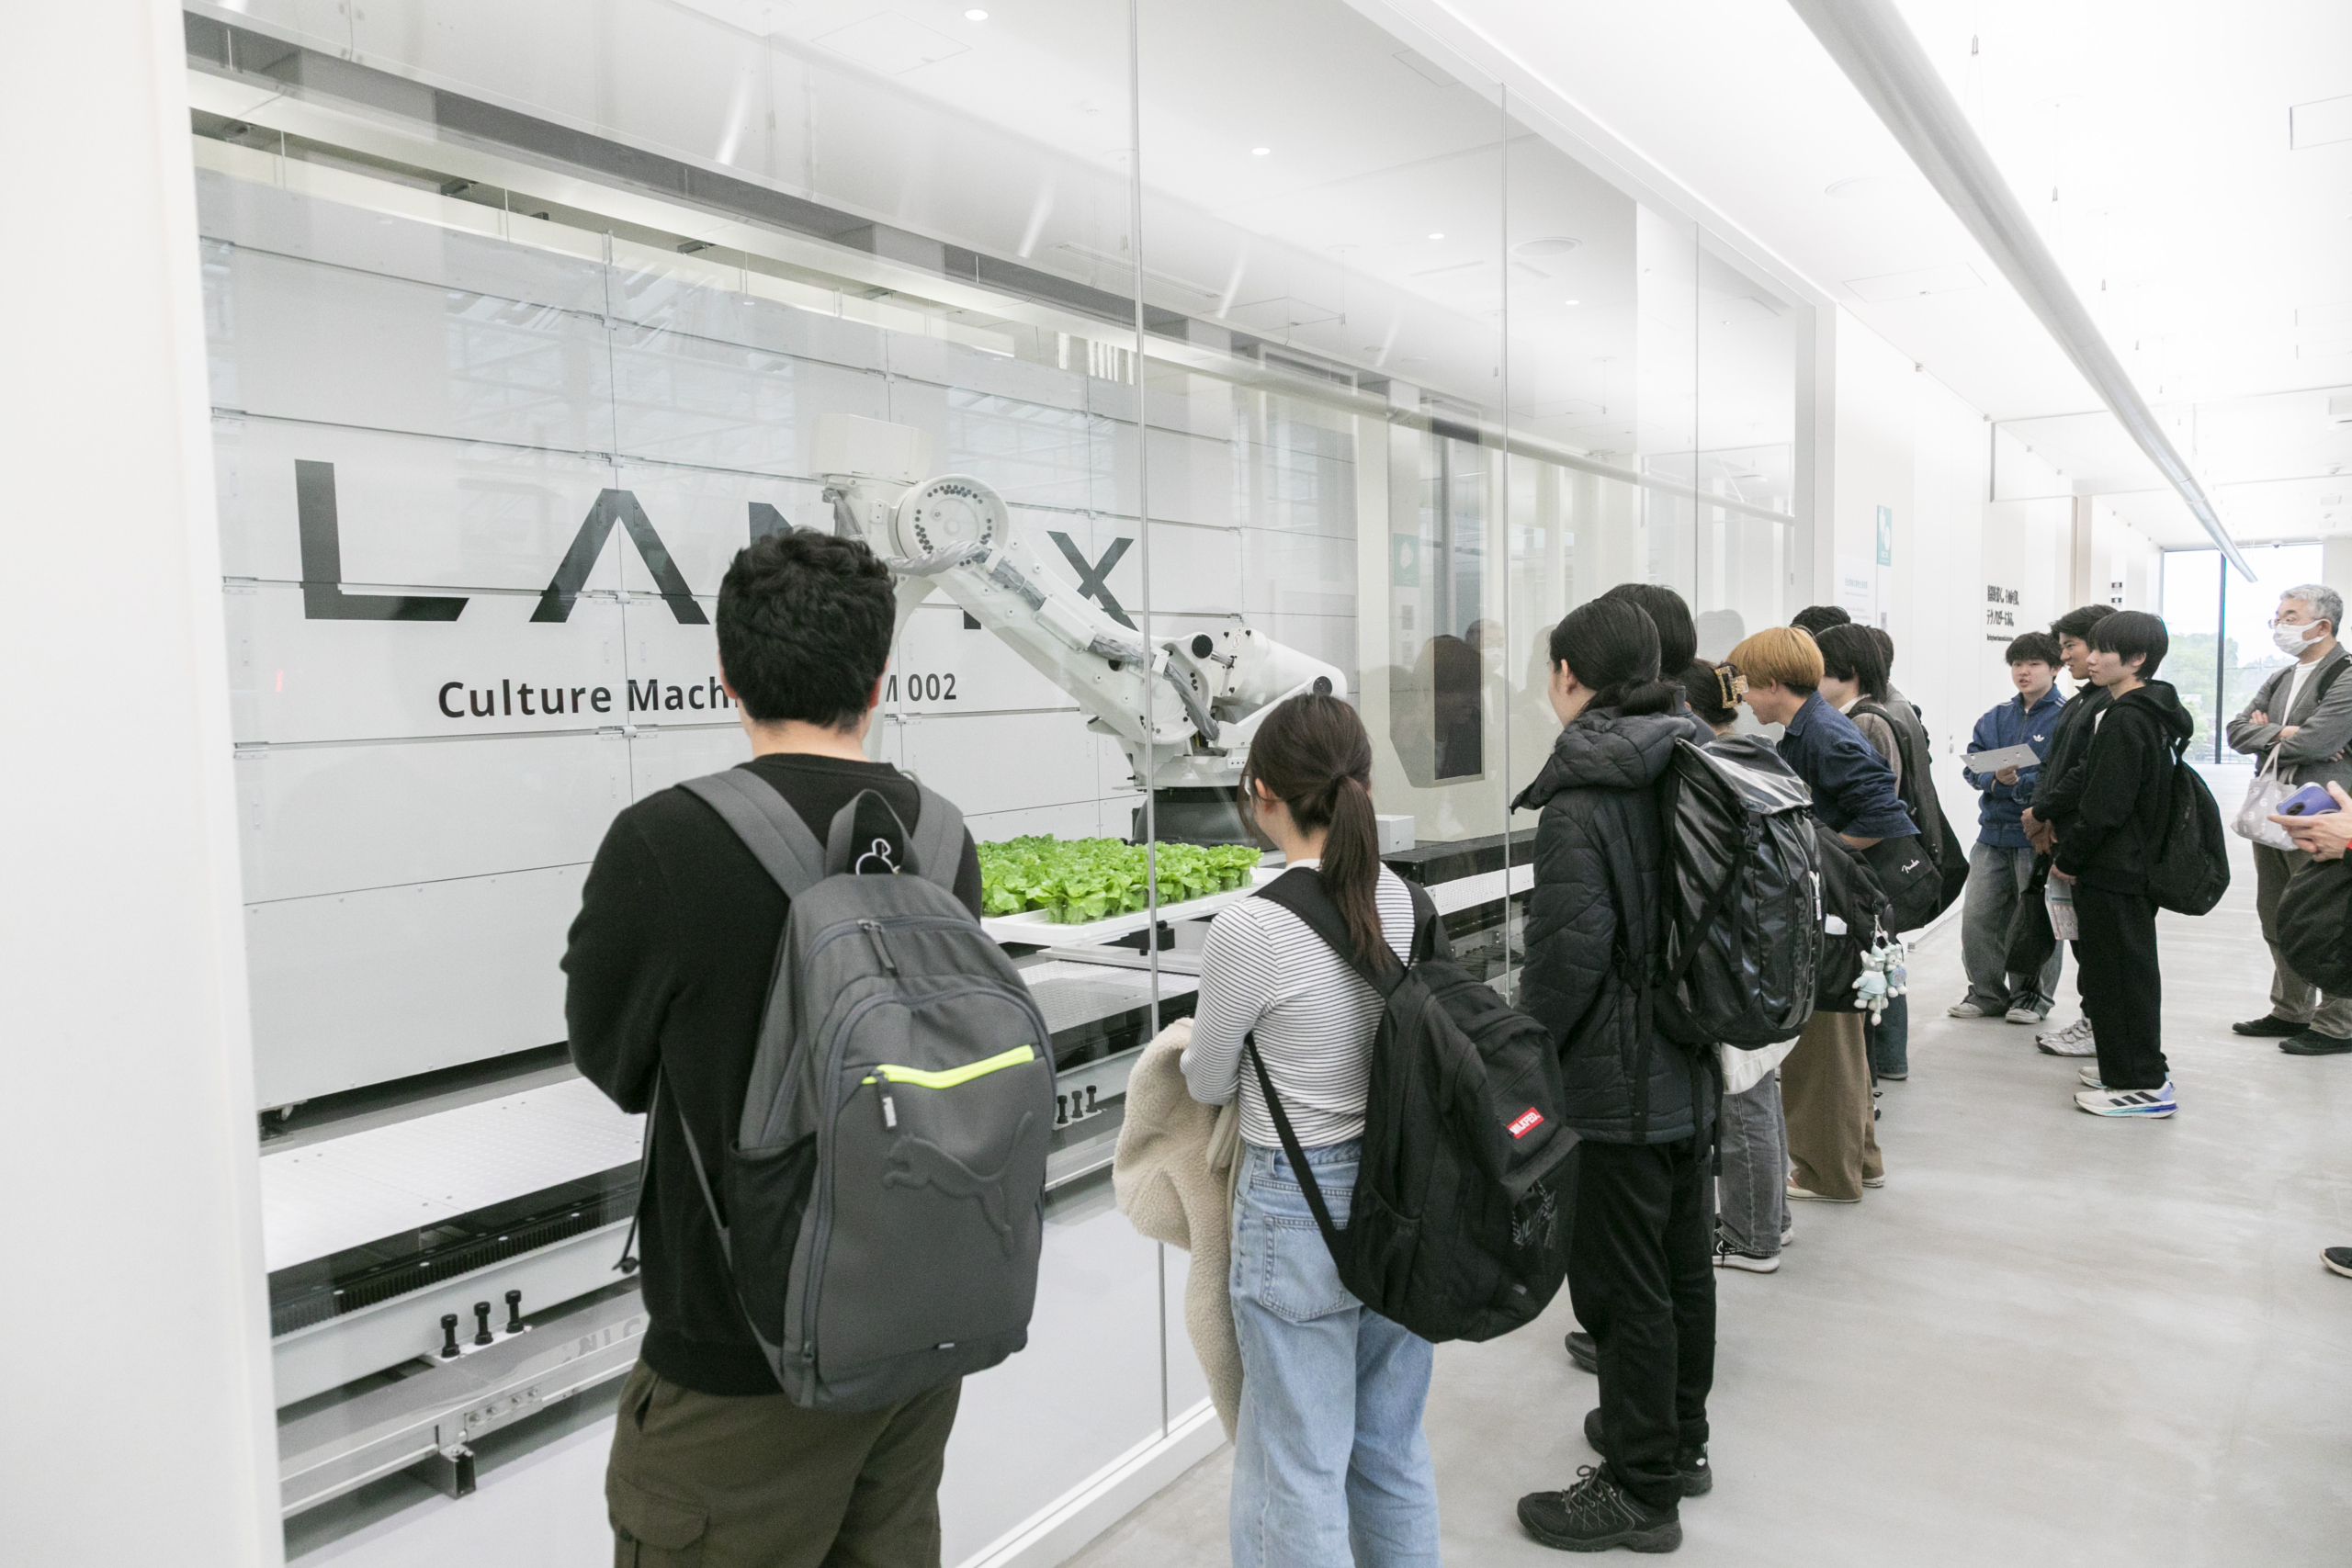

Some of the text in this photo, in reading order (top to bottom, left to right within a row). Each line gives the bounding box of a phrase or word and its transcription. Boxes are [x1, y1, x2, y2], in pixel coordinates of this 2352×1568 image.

[438, 679, 612, 717] Culture
[628, 676, 739, 711] Mach
[908, 672, 956, 702] 002
